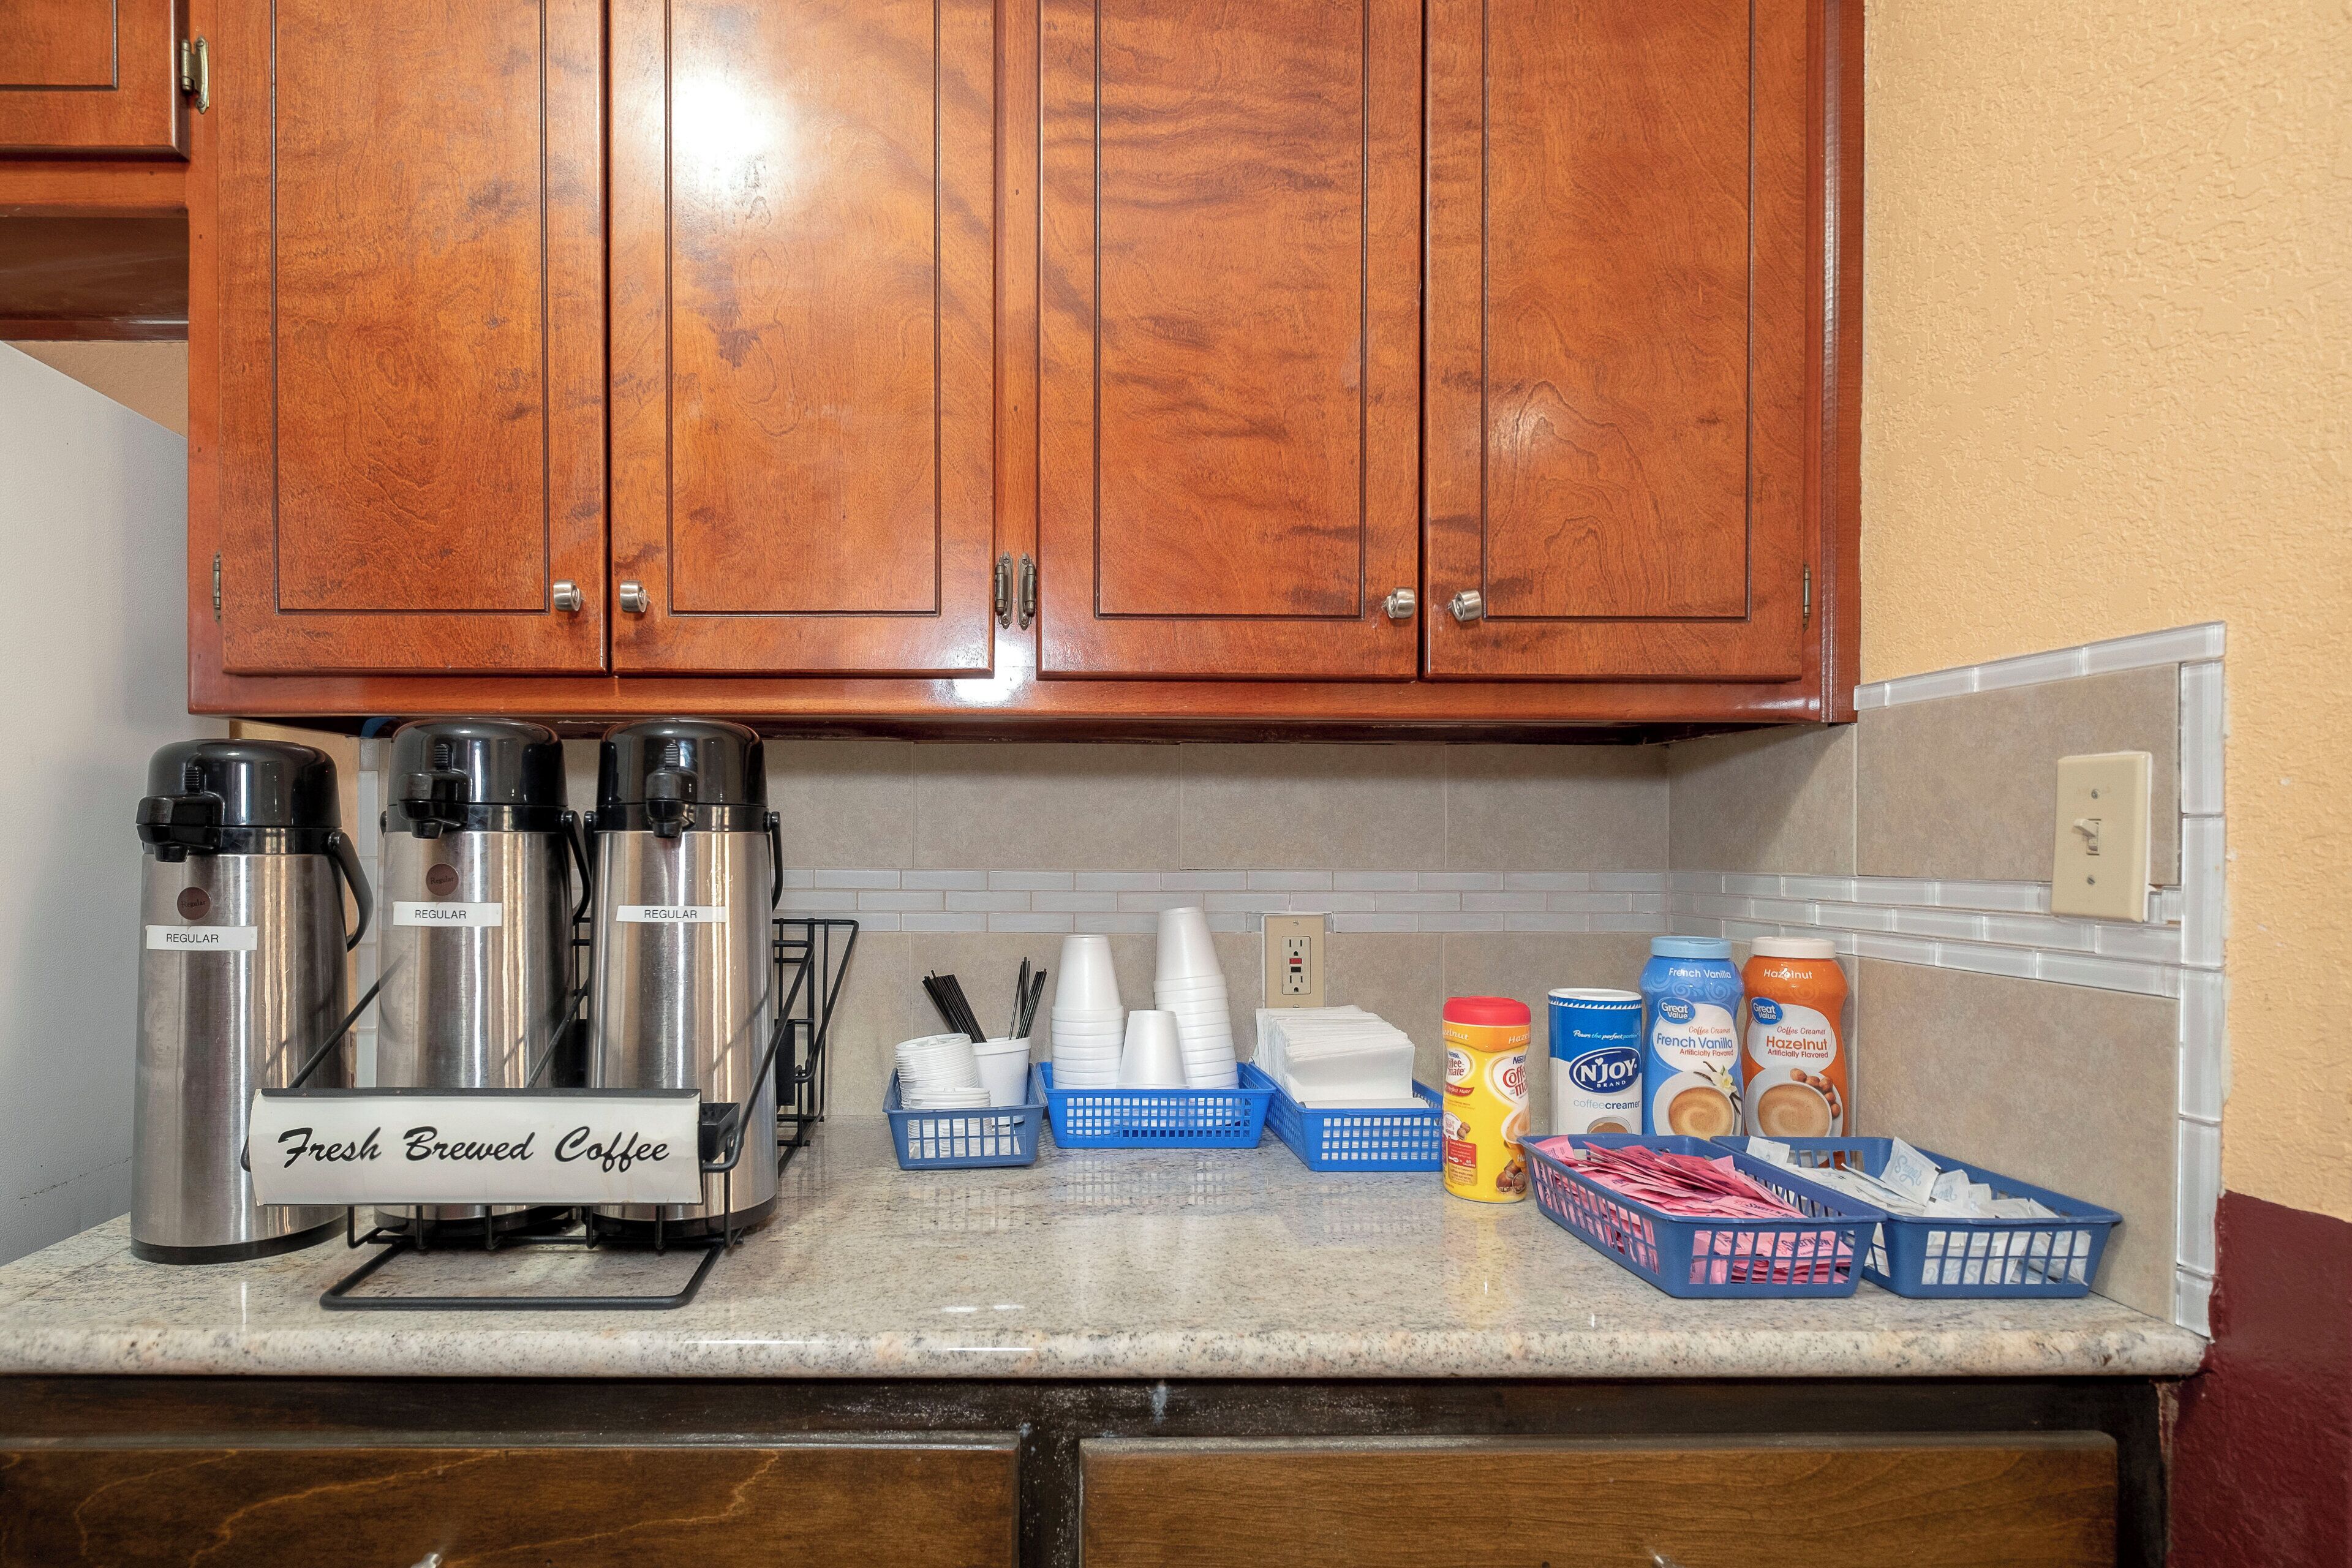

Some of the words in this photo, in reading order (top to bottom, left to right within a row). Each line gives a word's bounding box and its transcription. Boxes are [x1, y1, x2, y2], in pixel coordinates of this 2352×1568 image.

[431, 876, 454, 885] Regular
[181, 899, 206, 908] Regular
[415, 910, 467, 919] REGULAR
[644, 910, 697, 919] REGULAR
[166, 933, 219, 943] REGULAR
[1668, 967, 1701, 978] French
[1703, 969, 1732, 979] Vanilla
[1763, 968, 1812, 979] Hazelnut
[1662, 1002, 1689, 1014] Great
[1753, 1003, 1776, 1014] Great
[1442, 1028, 1469, 1041] zelnut
[1573, 1030, 1591, 1039] Pours
[1689, 1026, 1709, 1035] Coffee
[1777, 1026, 1798, 1035] Coffee
[1800, 1027, 1826, 1035] Creamer
[1656, 1033, 1696, 1048] French
[1698, 1036, 1733, 1049] Vanilla
[1766, 1035, 1828, 1050] Hazelnut
[1679, 1049, 1711, 1057] Artificially
[1768, 1049, 1800, 1058] Artificially
[1597, 1080, 1626, 1088] BRAND
[277, 1126, 382, 1169] Fresh
[403, 1126, 535, 1161] Brewed
[554, 1126, 669, 1173] Coffee
[1895, 1154, 1922, 1186] Sugar
